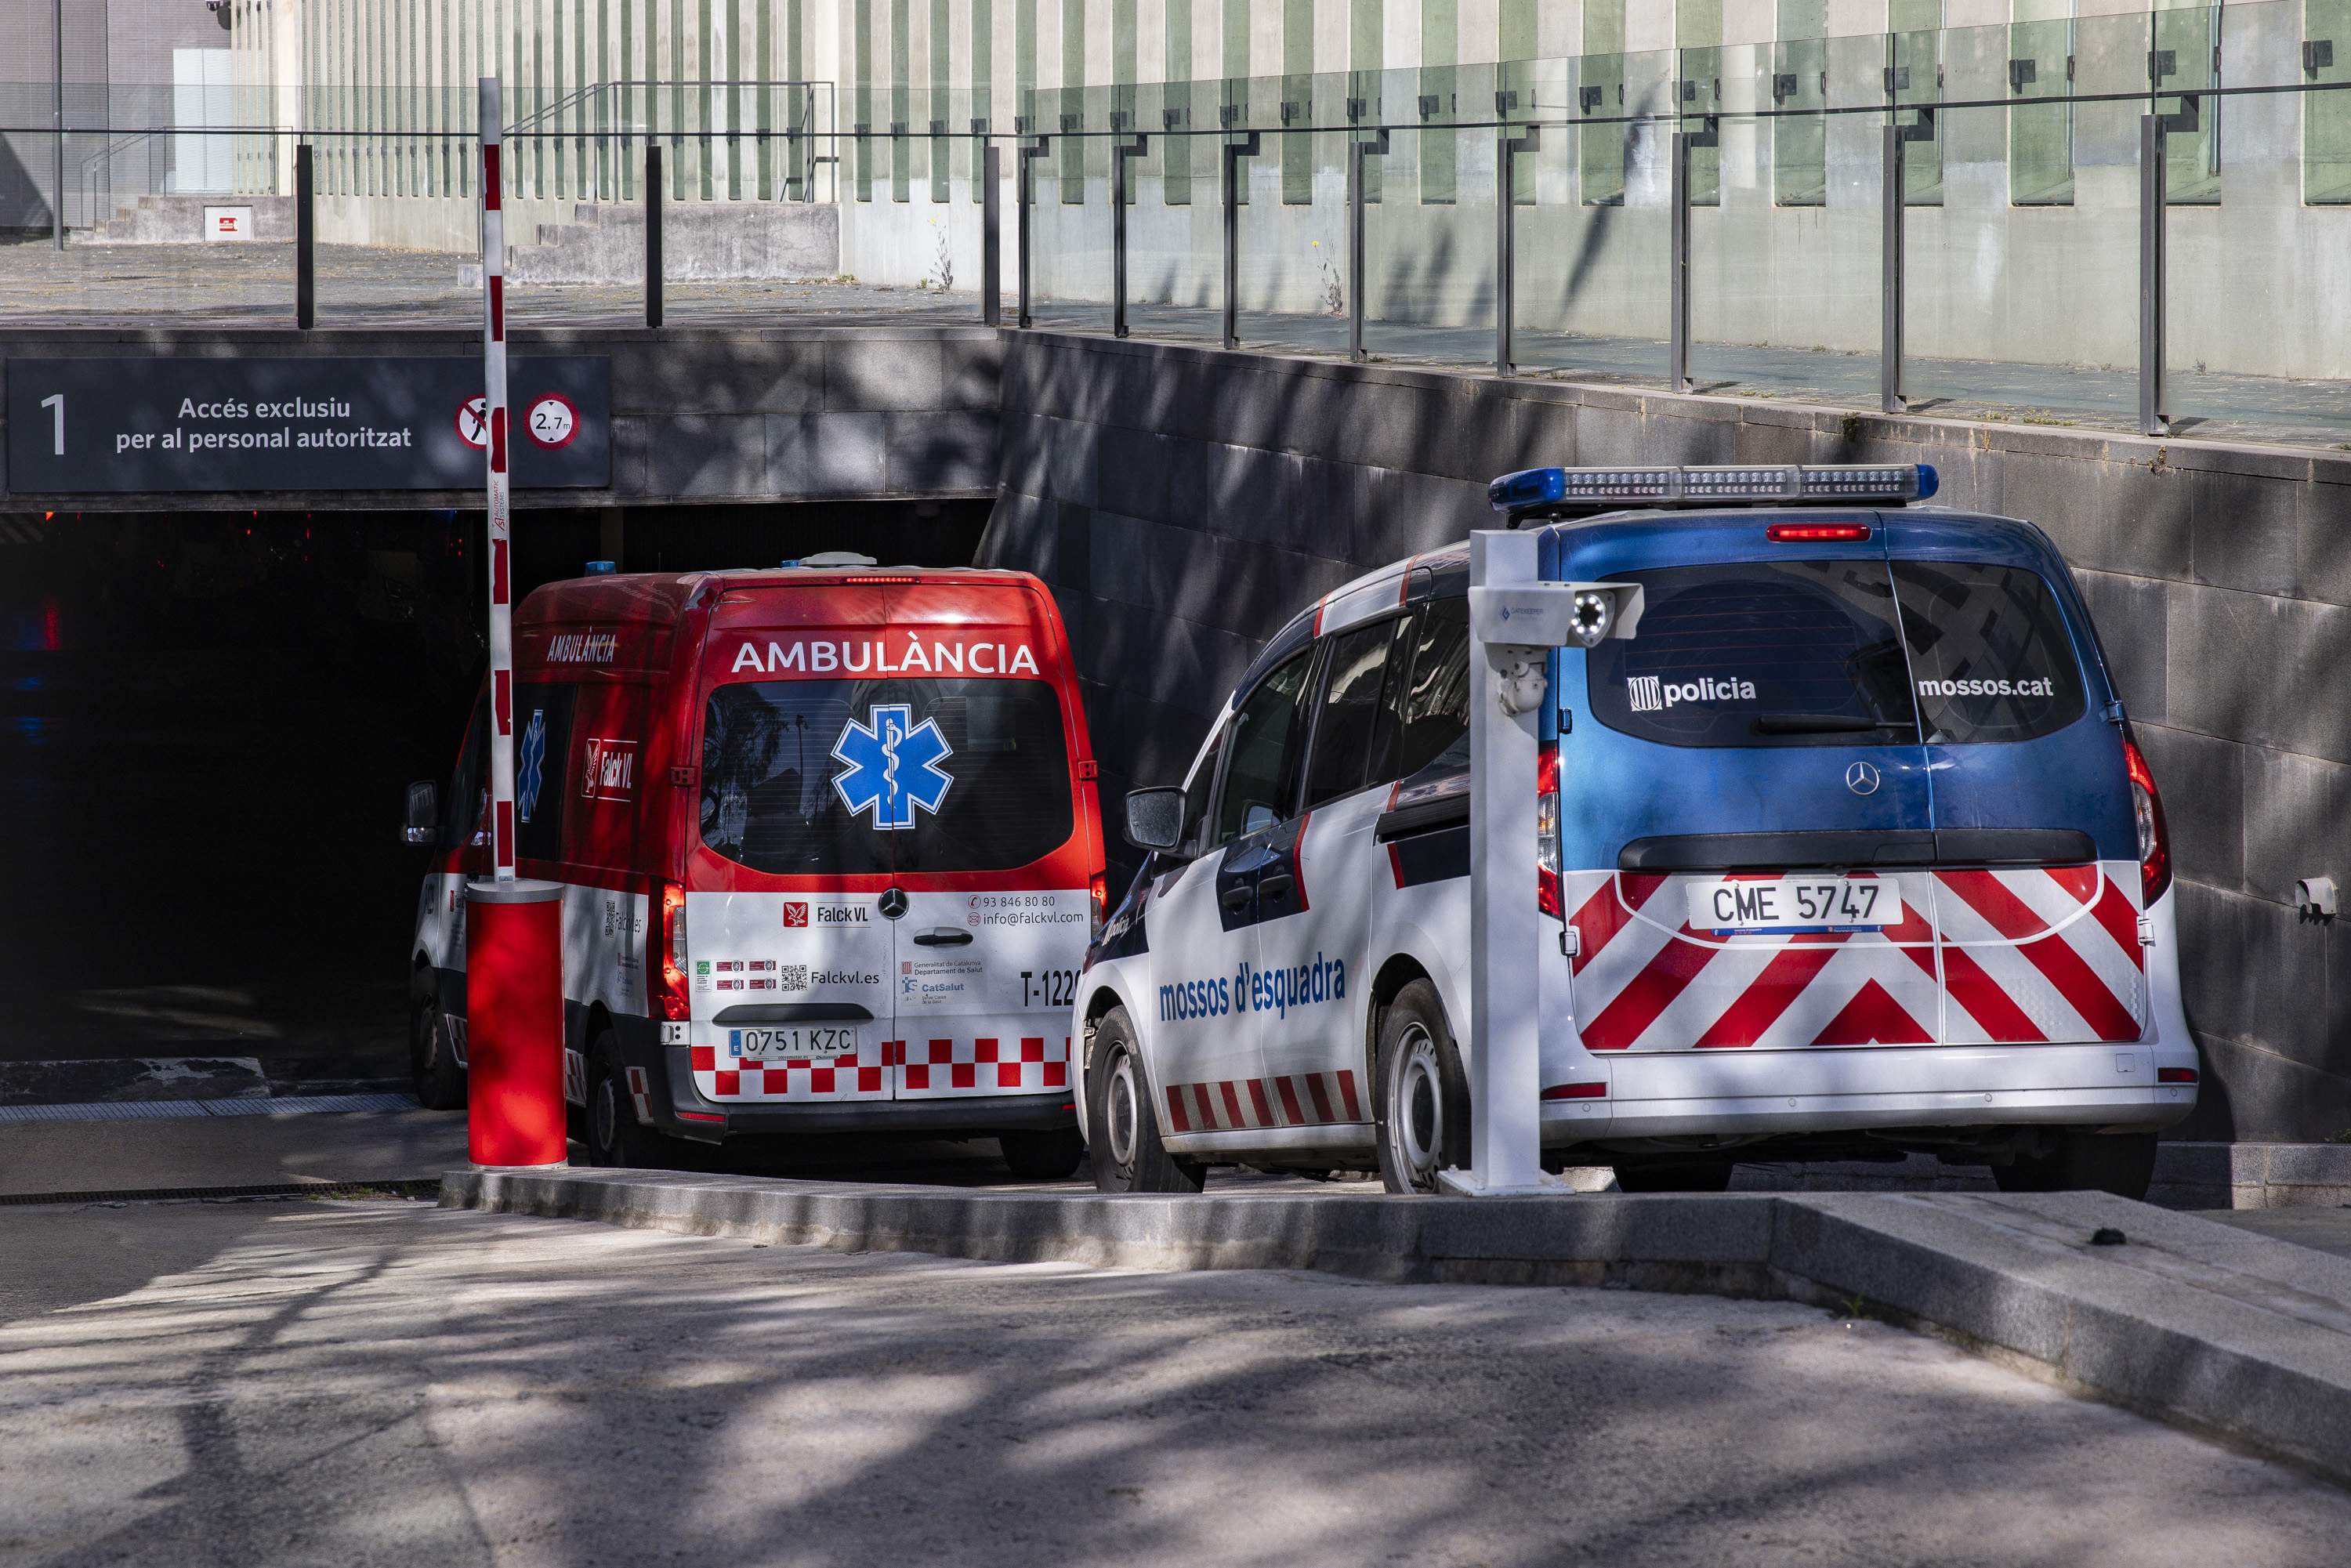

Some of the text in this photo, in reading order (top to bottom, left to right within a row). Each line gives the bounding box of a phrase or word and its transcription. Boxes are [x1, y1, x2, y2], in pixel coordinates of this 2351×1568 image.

[178, 397, 350, 418] Accés exclusiu
[42, 394, 64, 454] 1
[116, 427, 411, 454] per al personal autoritzat
[547, 625, 616, 663] AMBULÀNCIA
[731, 631, 1040, 675] AMBULÀNCIA
[1663, 676, 1756, 708] policia
[1918, 677, 2054, 697] mossos.cat
[600, 751, 633, 789] Falck VL
[984, 896, 1055, 907] 93 846 80 80
[1713, 886, 1780, 922] CME
[1796, 885, 1879, 919] 5747
[817, 907, 868, 922] Falck VL
[984, 911, 1084, 926] info@falckvl.com
[811, 971, 879, 984] Falckvl.es
[922, 983, 965, 992] CatSalut
[1160, 951, 1346, 1022] mossos d'esquadra
[746, 1029, 851, 1052] 0751 KZC
